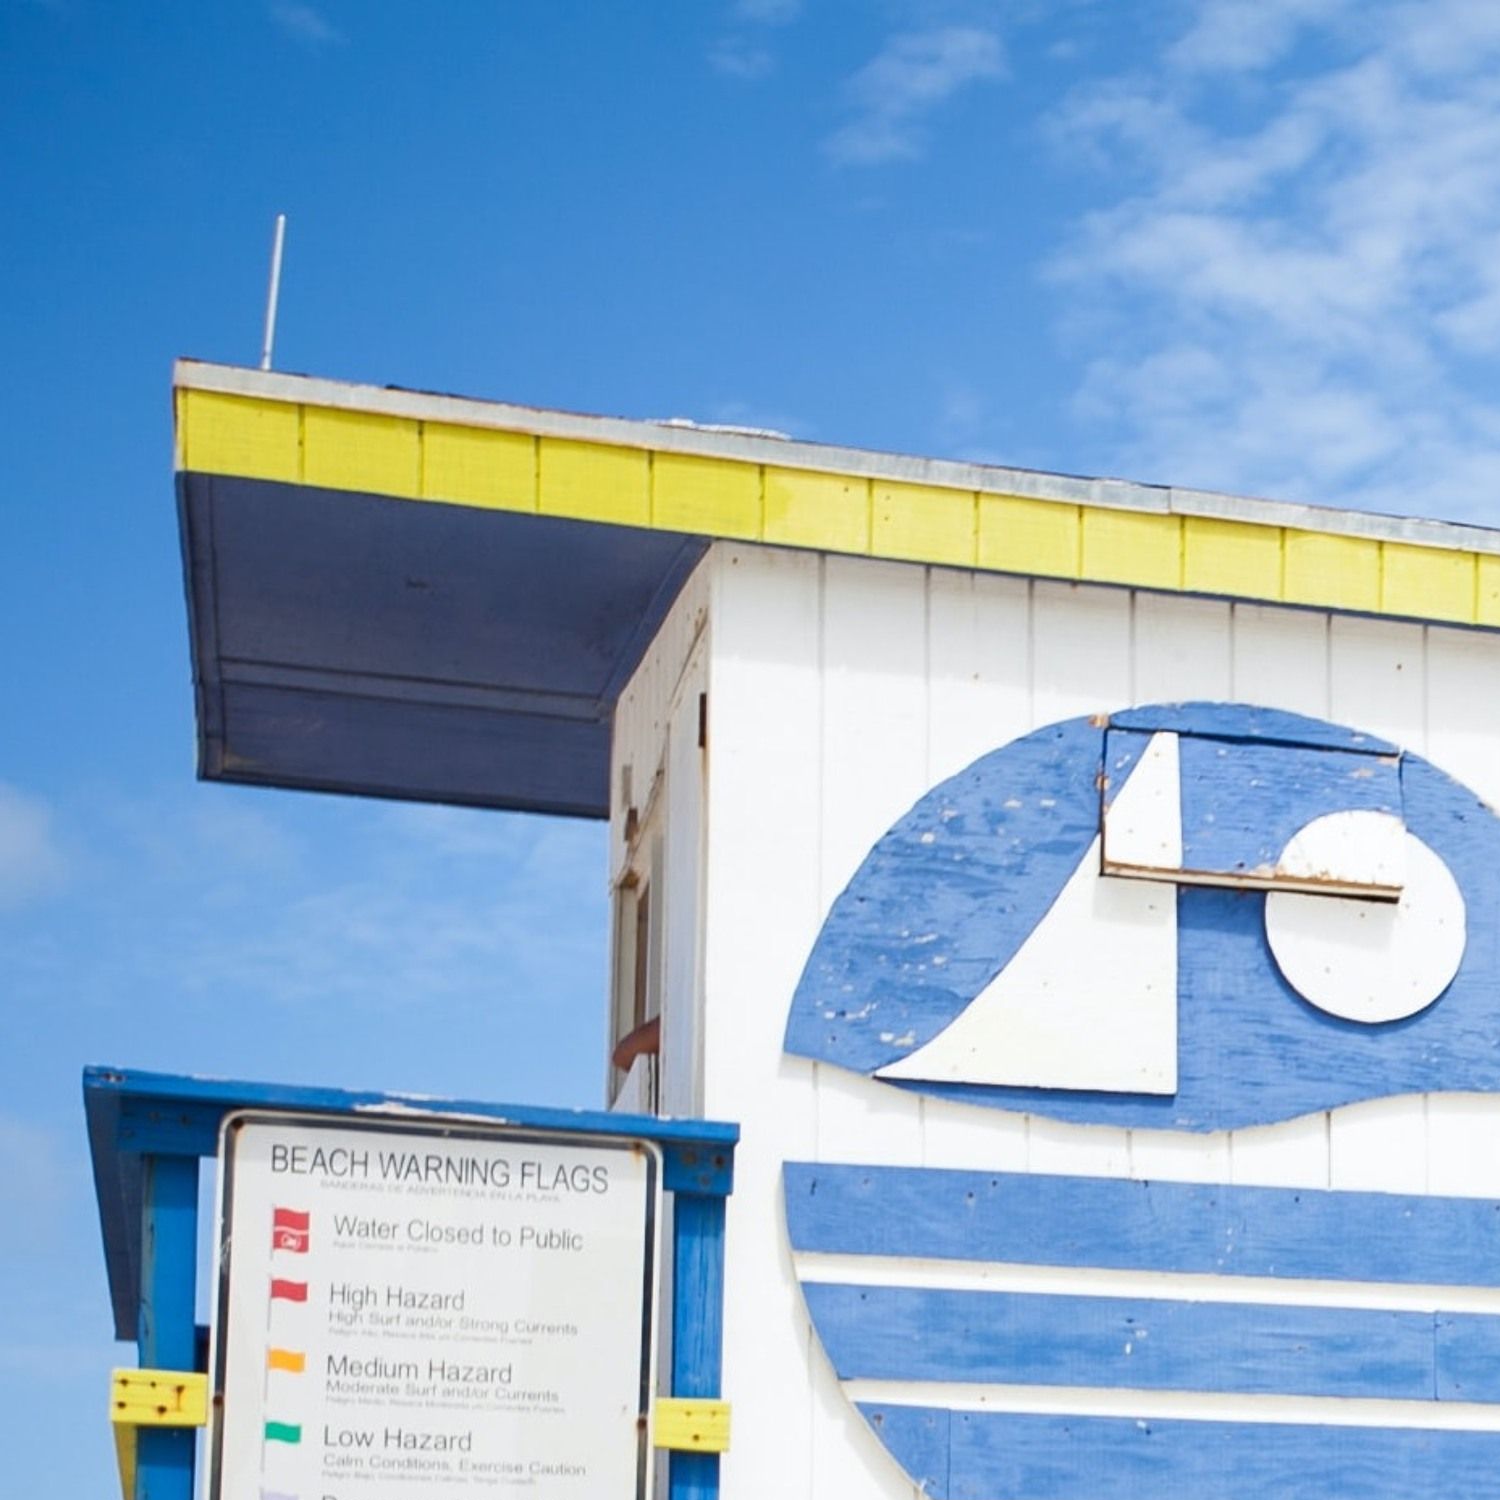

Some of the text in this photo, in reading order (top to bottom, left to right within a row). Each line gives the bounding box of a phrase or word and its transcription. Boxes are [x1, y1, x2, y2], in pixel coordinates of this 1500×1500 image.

[271, 1145, 608, 1194] BEACH WARNING FLAGS
[334, 1215, 583, 1252] Water Closed to Public
[329, 1284, 465, 1311] High Hazard
[329, 1311, 369, 1328] High
[371, 1313, 404, 1328] Surf
[410, 1314, 453, 1331] and/or
[459, 1317, 509, 1335] Strong
[514, 1320, 578, 1337] Currents
[327, 1355, 513, 1384] Medium Hazard
[325, 1380, 560, 1403] Moderate Surf and/or Currents
[324, 1426, 472, 1452] Low Hazard
[323, 1454, 364, 1469] Calm
[459, 1460, 523, 1475] Exercise
[529, 1462, 586, 1477] Caution
